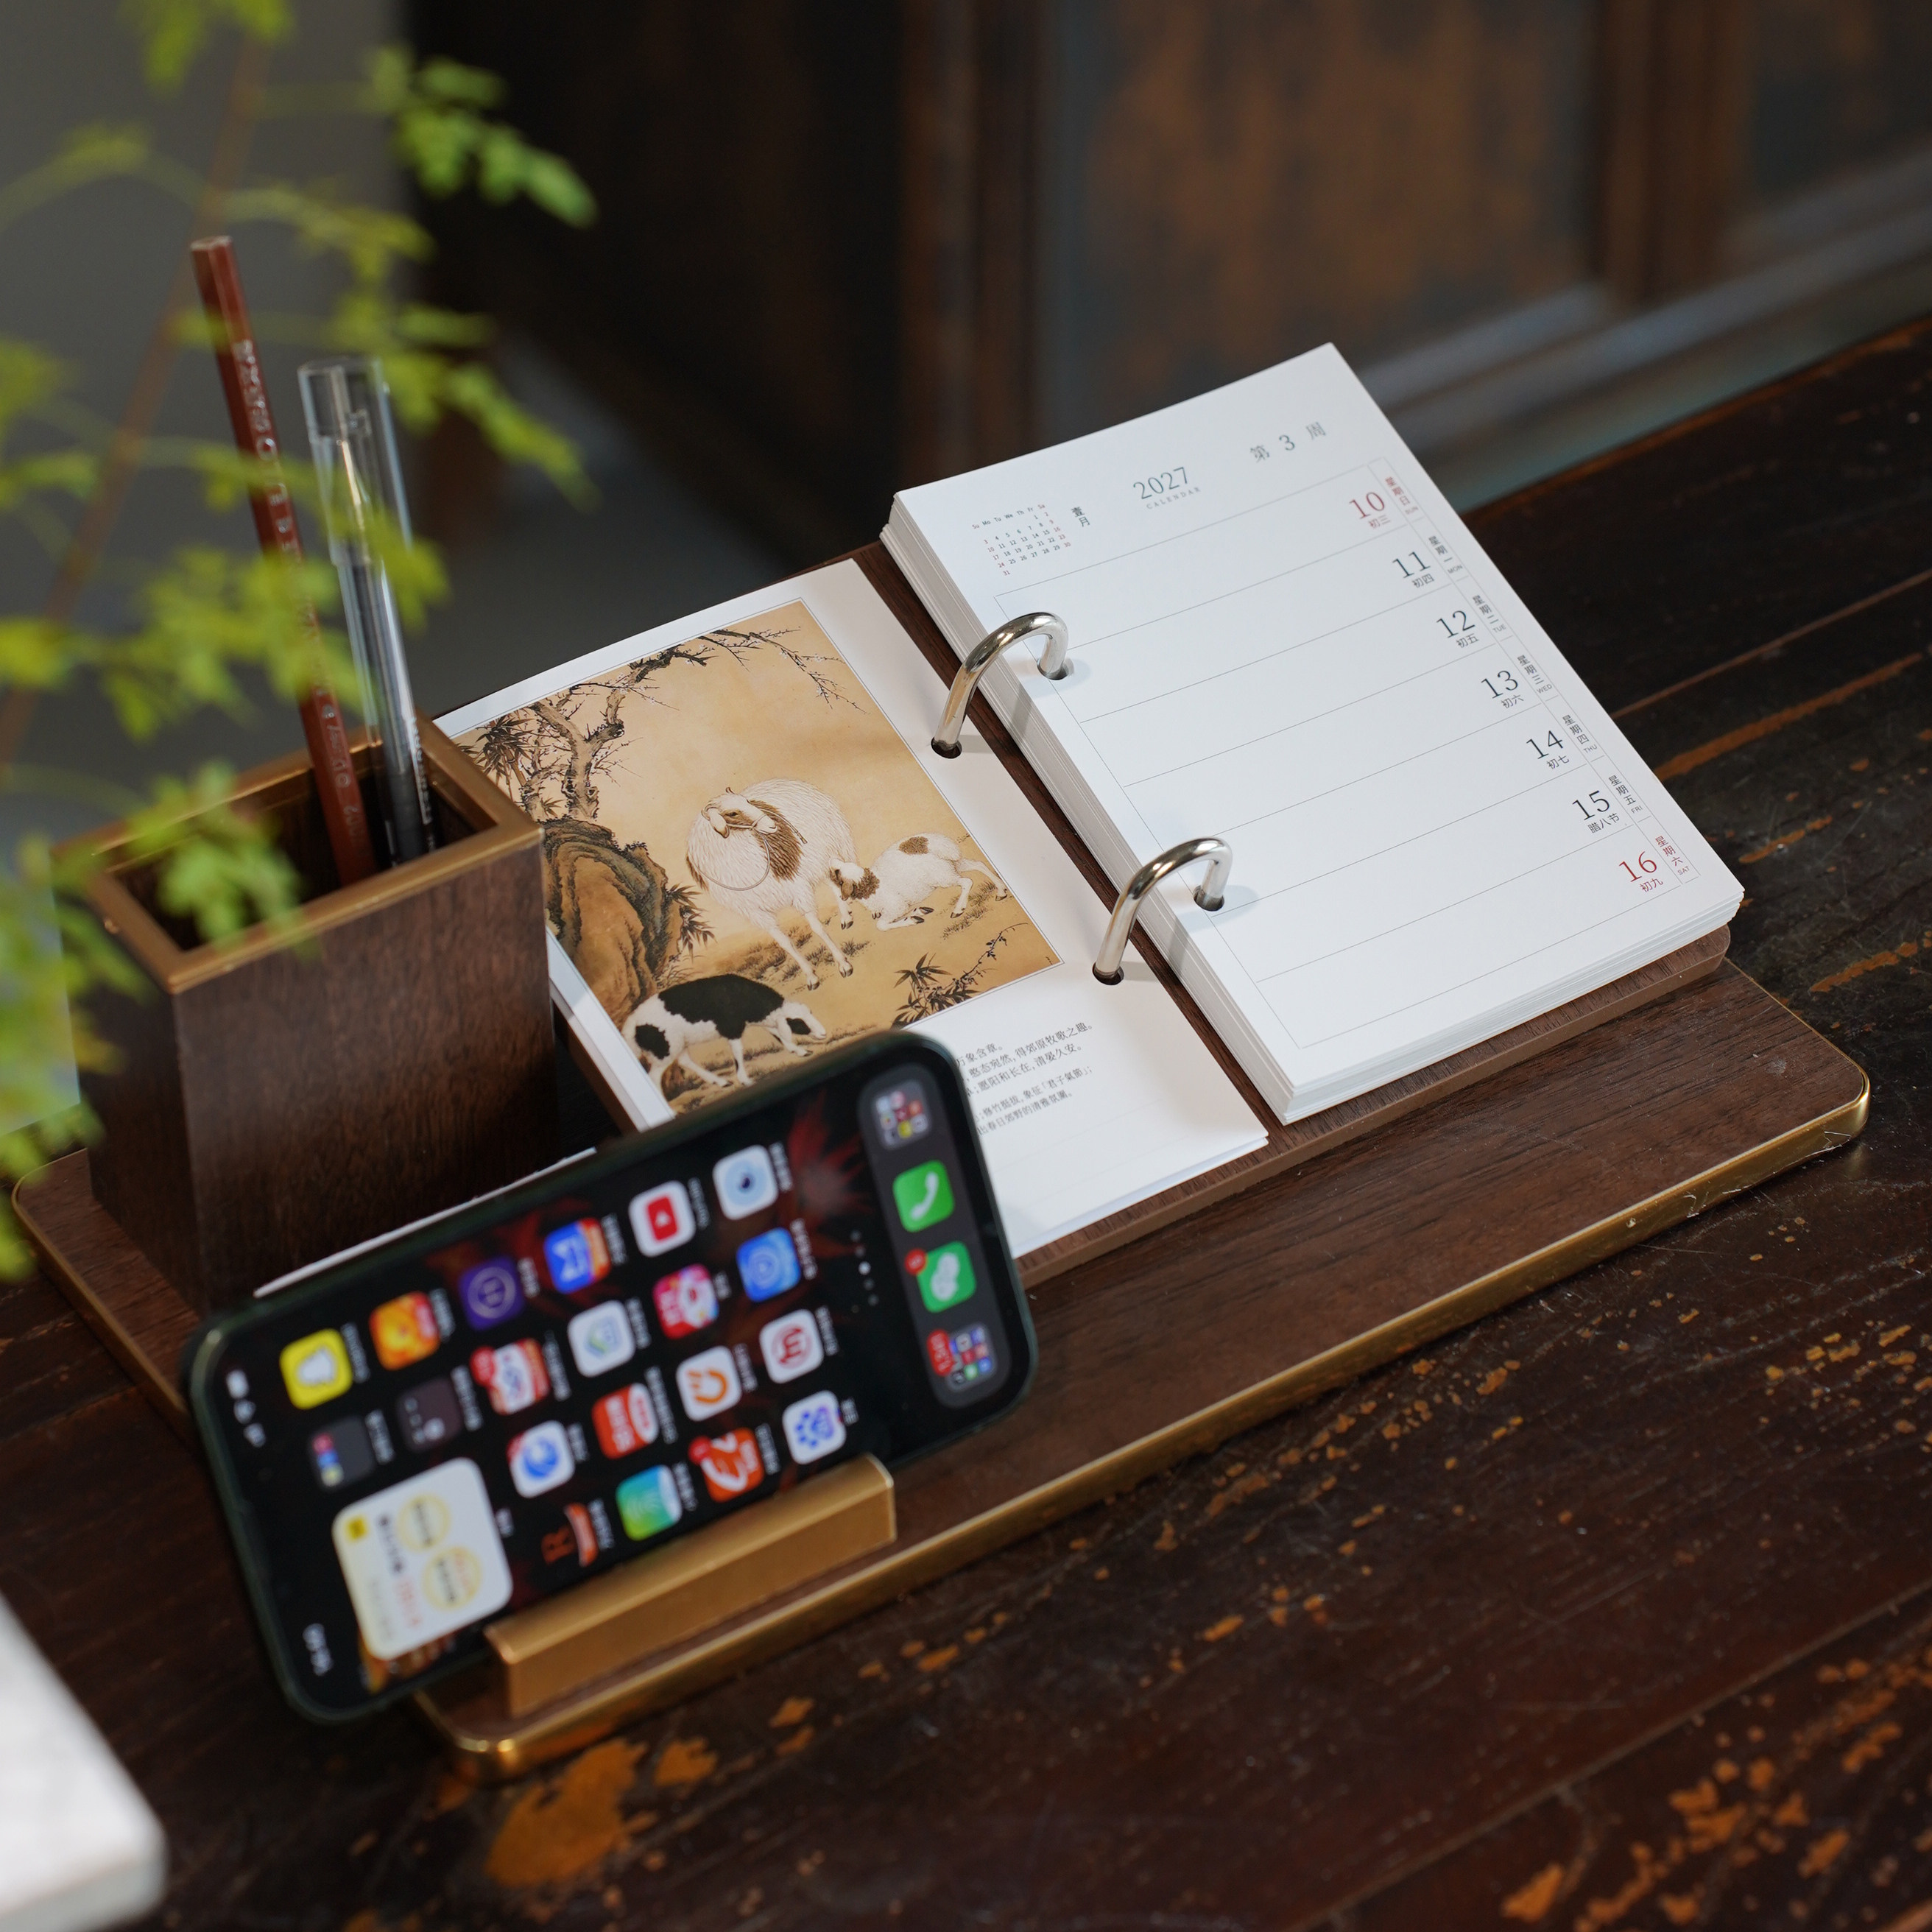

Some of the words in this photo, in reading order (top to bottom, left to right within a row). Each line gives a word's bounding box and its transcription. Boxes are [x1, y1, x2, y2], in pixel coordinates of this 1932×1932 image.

[1250, 444, 1270, 463] 第
[1278, 434, 1296, 451] 3
[1305, 421, 1326, 441] 周
[1132, 466, 1189, 501] 2027
[1146, 486, 1201, 510] CALENDAR
[1349, 492, 1385, 519] 10
[1428, 535, 1453, 563] 星期一
[1392, 551, 1431, 578] 11
[1448, 564, 1463, 574] MON
[1411, 574, 1434, 588] 初四
[1472, 594, 1499, 624] 星期二
[1436, 610, 1476, 638] 12
[1492, 624, 1506, 633] TUE
[1456, 634, 1478, 649] 初五
[1517, 655, 1545, 684] 星期三
[1481, 670, 1519, 699] 13
[1537, 683, 1553, 694] WED
[1501, 694, 1524, 710] 初六
[1562, 714, 1590, 745] 星期四
[1526, 730, 1563, 760] 14
[1583, 744, 1598, 755] THU
[1546, 754, 1570, 770] 初七
[1609, 775, 1636, 805] 星期五
[1572, 790, 1610, 821] 15
[1631, 805, 1643, 814] FRI
[1587, 812, 1620, 834] 腊八节
[1655, 835, 1684, 867] 星期六
[1618, 851, 1658, 883] 16
[1677, 865, 1690, 875] SAT
[1640, 877, 1664, 893] 初九
